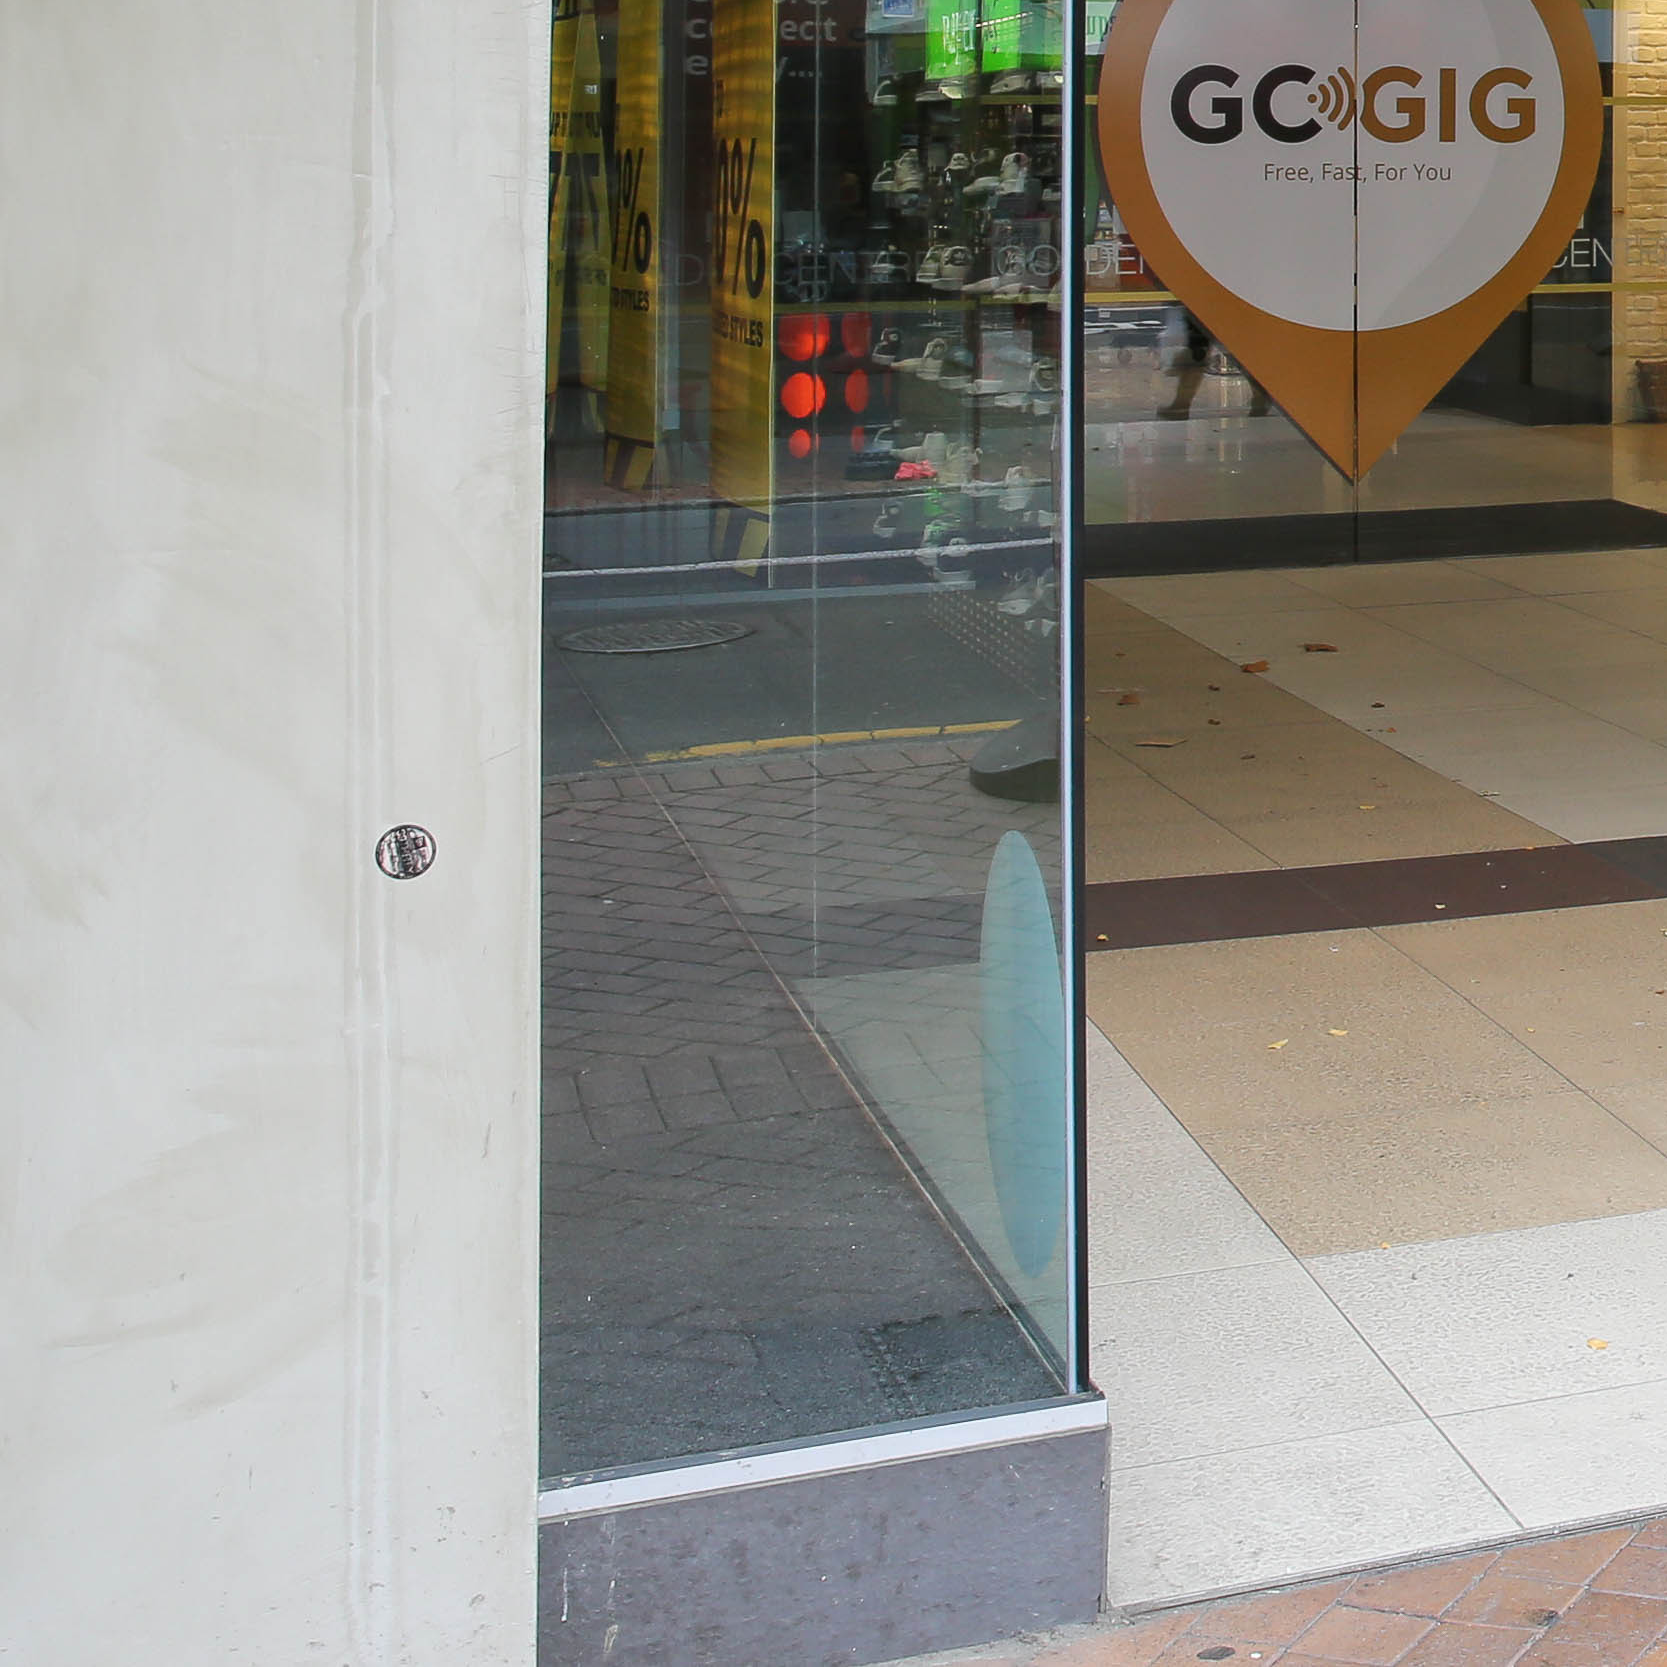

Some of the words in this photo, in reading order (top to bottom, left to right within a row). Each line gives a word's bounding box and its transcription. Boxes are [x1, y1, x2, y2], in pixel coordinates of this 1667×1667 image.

[1360, 66, 1537, 144] GIG
[1263, 163, 1315, 184] Free,
[1321, 162, 1370, 184] Fast,
[1374, 162, 1408, 181] For
[1413, 162, 1452, 182] You
